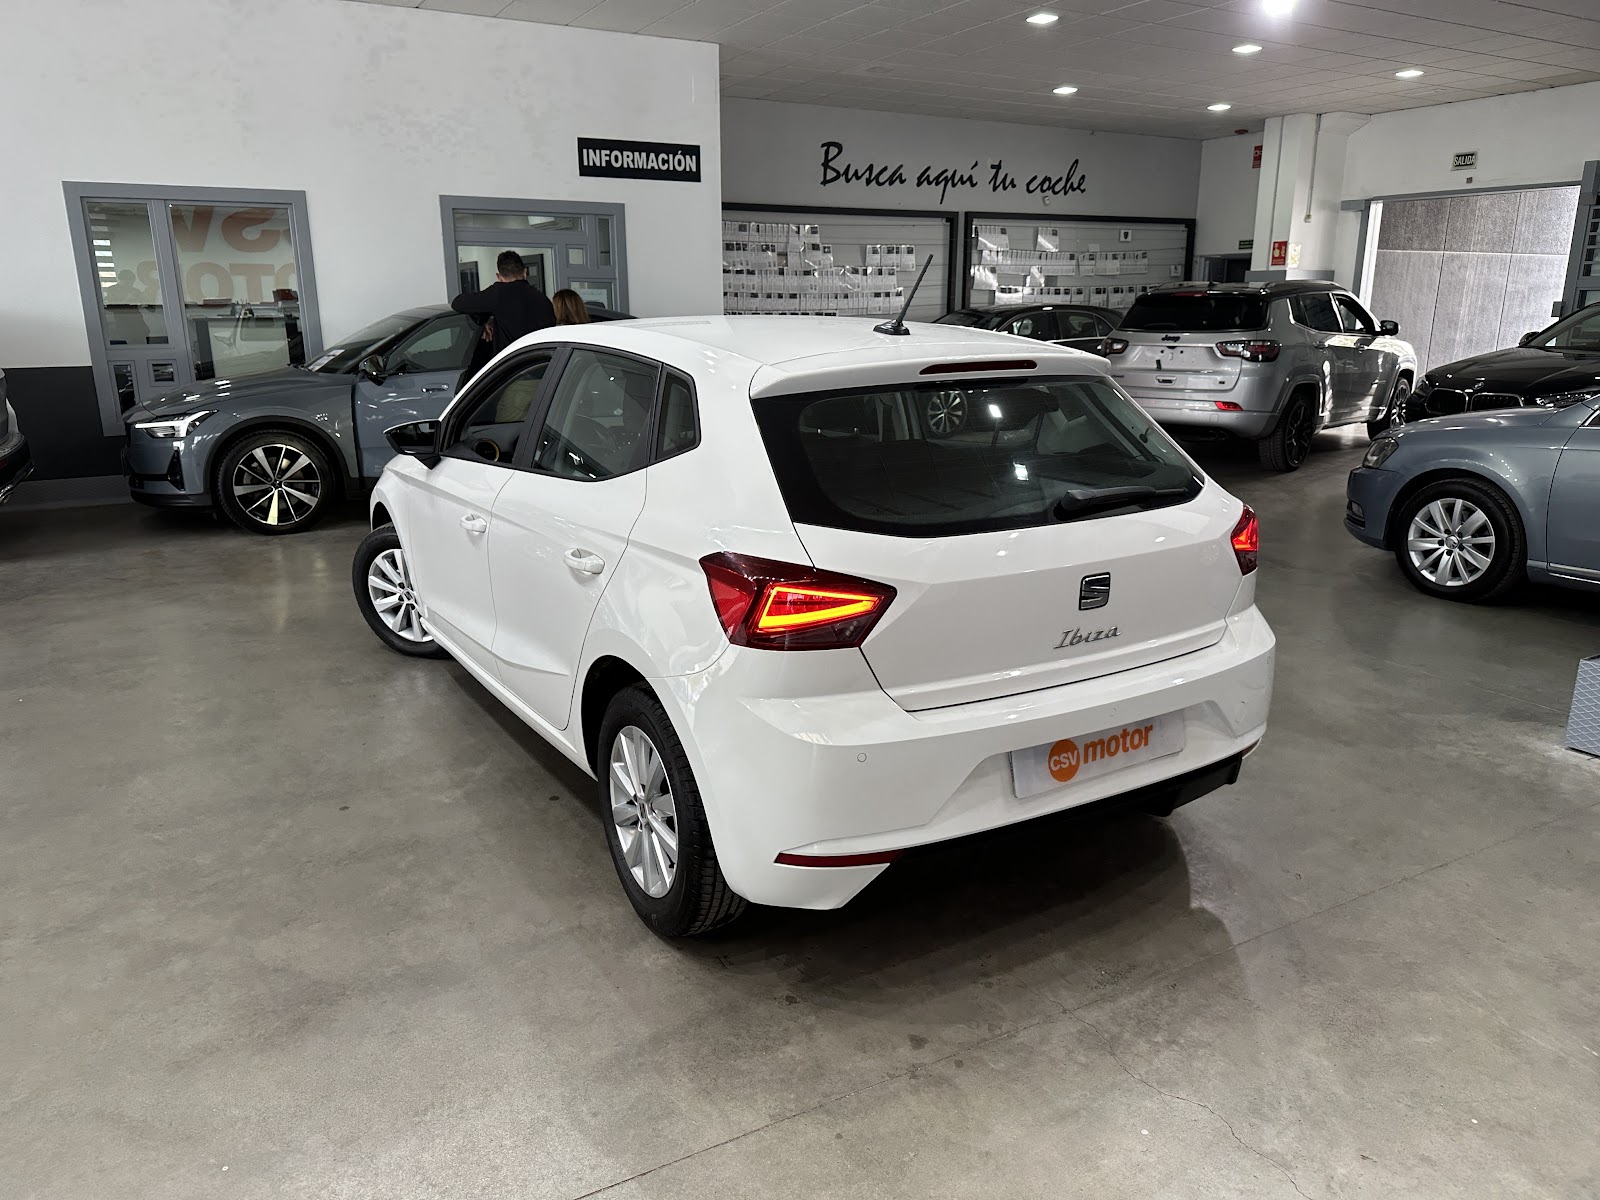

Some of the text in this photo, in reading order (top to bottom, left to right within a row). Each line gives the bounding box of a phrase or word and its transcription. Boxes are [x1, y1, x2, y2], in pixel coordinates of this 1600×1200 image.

[582, 148, 697, 172] INFORMACIÓN
[1454, 154, 1476, 166] SALIDA
[820, 141, 1087, 205] Busca aquí tu coche
[1053, 626, 1122, 650] Ibiza
[1083, 724, 1154, 764] motor
